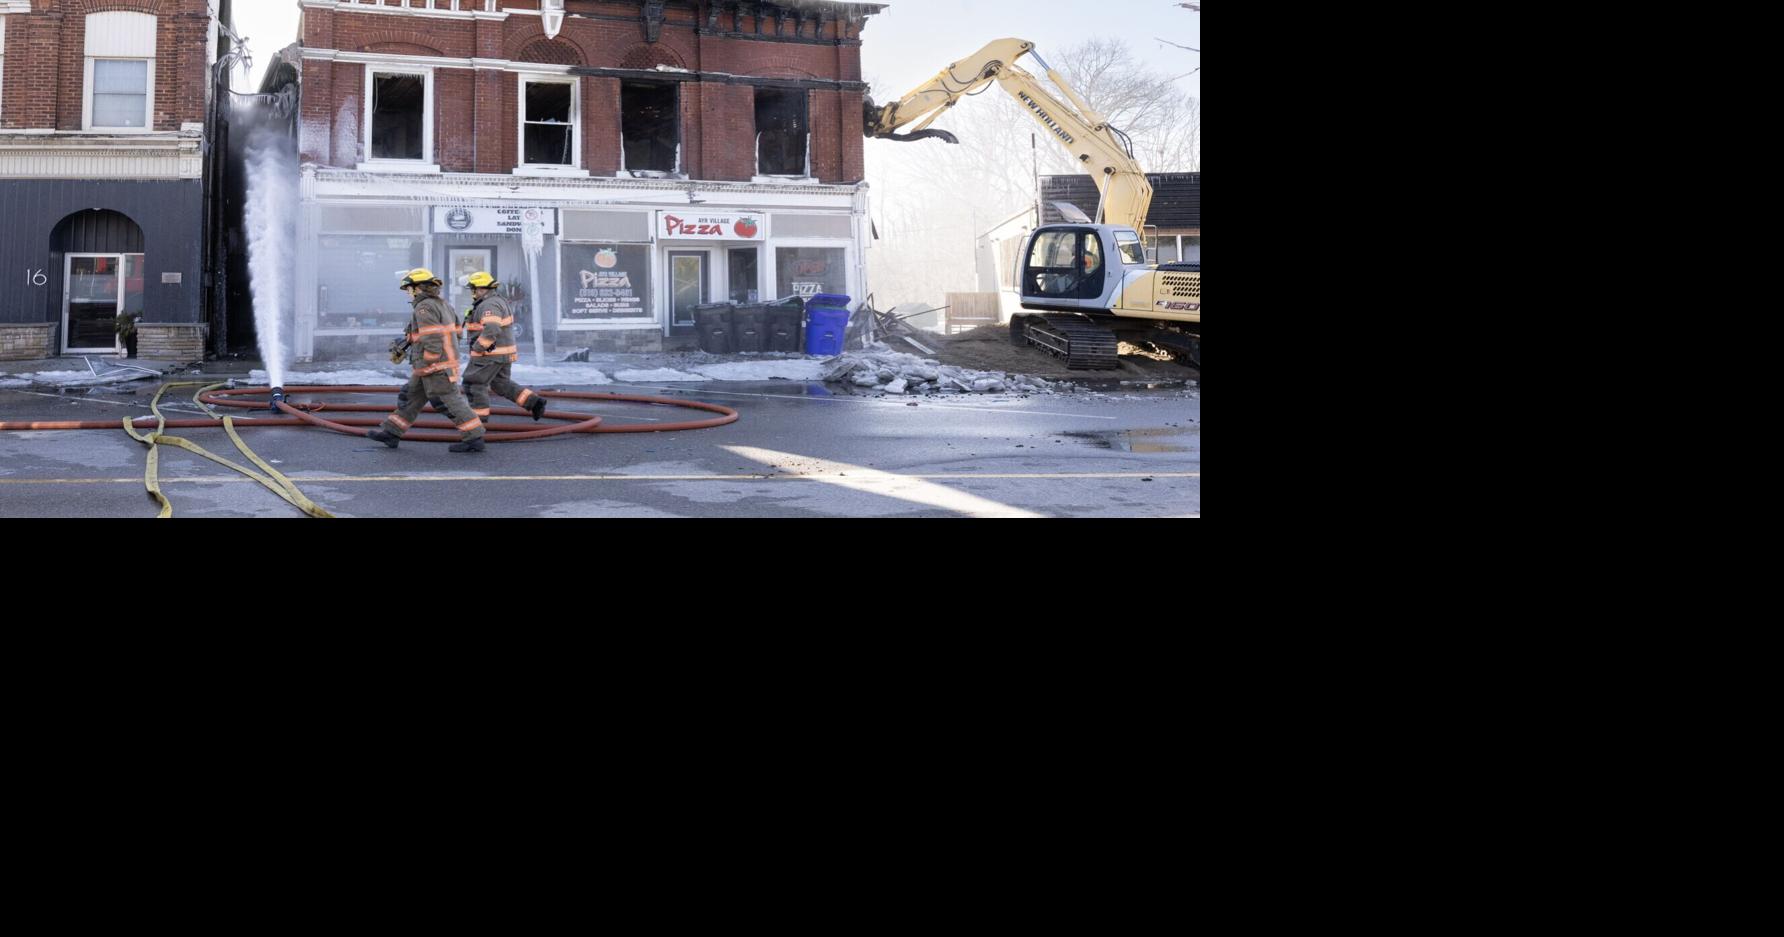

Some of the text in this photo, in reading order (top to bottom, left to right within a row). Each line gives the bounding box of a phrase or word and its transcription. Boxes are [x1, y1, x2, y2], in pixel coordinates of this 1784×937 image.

[1018, 91, 1074, 144] NEW HOLLAND
[664, 214, 723, 236] Pizza
[26, 268, 47, 286] 16
[793, 284, 823, 296] PIZZA
